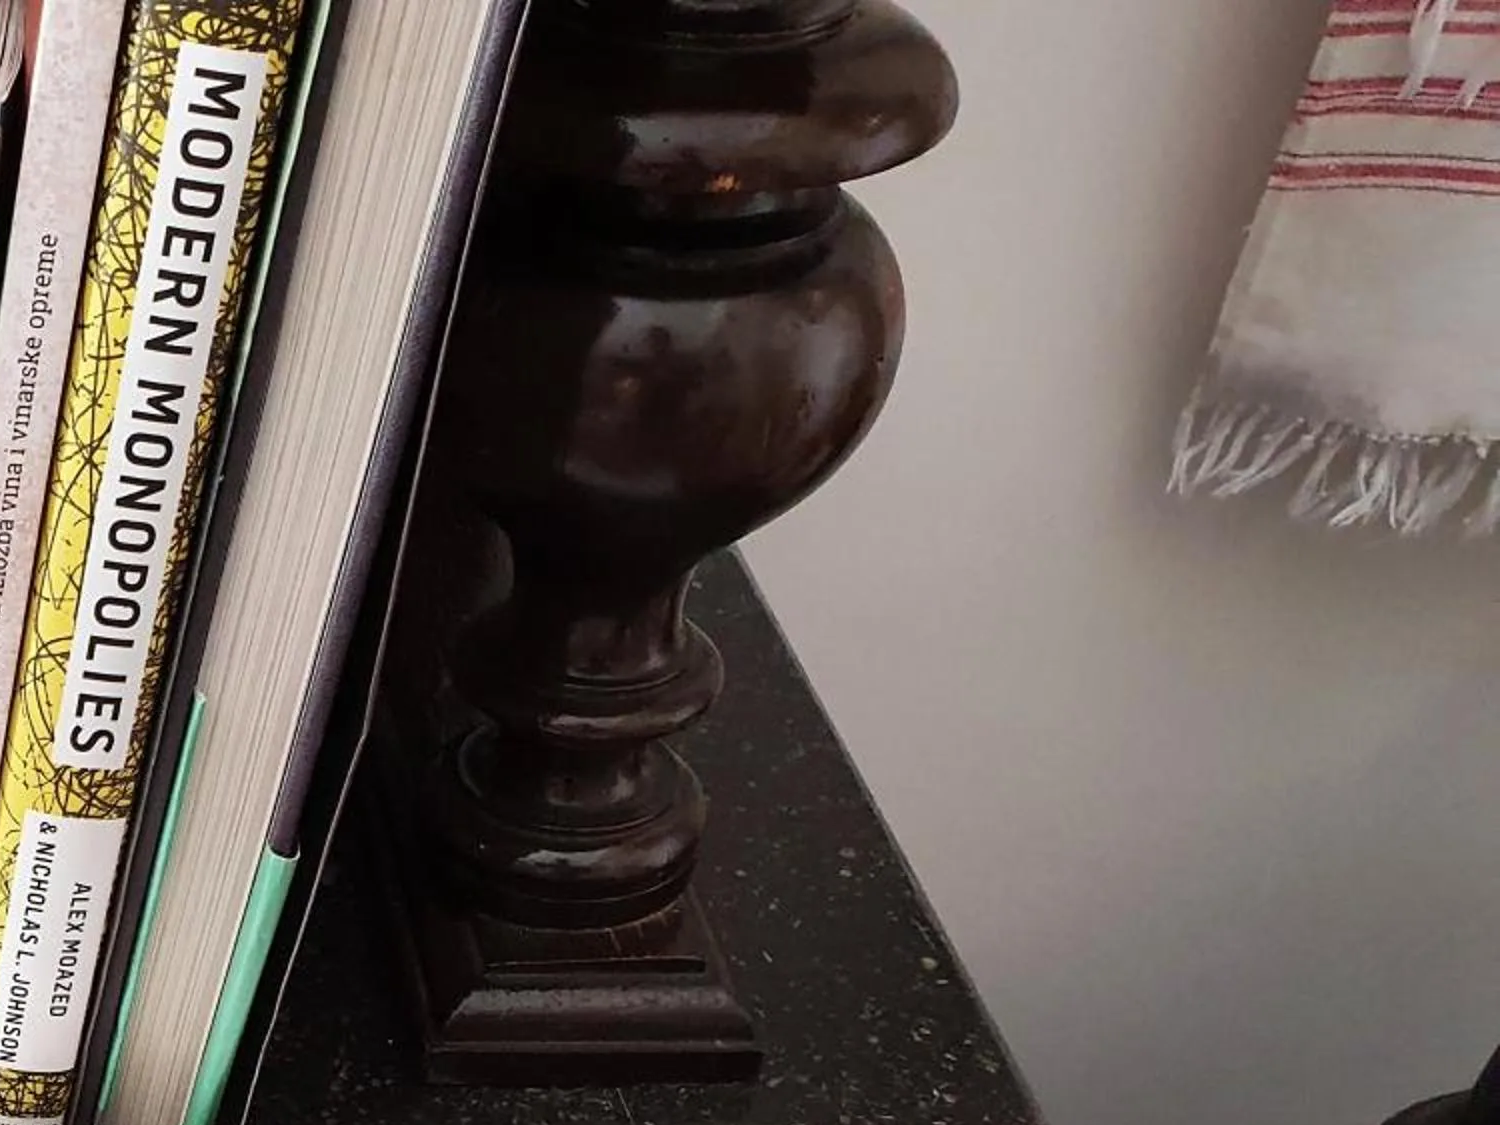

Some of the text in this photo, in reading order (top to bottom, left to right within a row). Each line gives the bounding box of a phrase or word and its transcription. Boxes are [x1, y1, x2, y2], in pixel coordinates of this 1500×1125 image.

[29, 233, 59, 329] opreme
[8, 337, 42, 441] vinarske
[70, 67, 247, 753] MODERN MONOPOLIES
[4, 447, 26, 457] i
[38, 820, 57, 835] &
[19, 841, 57, 945] NICHOLAS
[50, 882, 92, 1018] ALEX MOAZED
